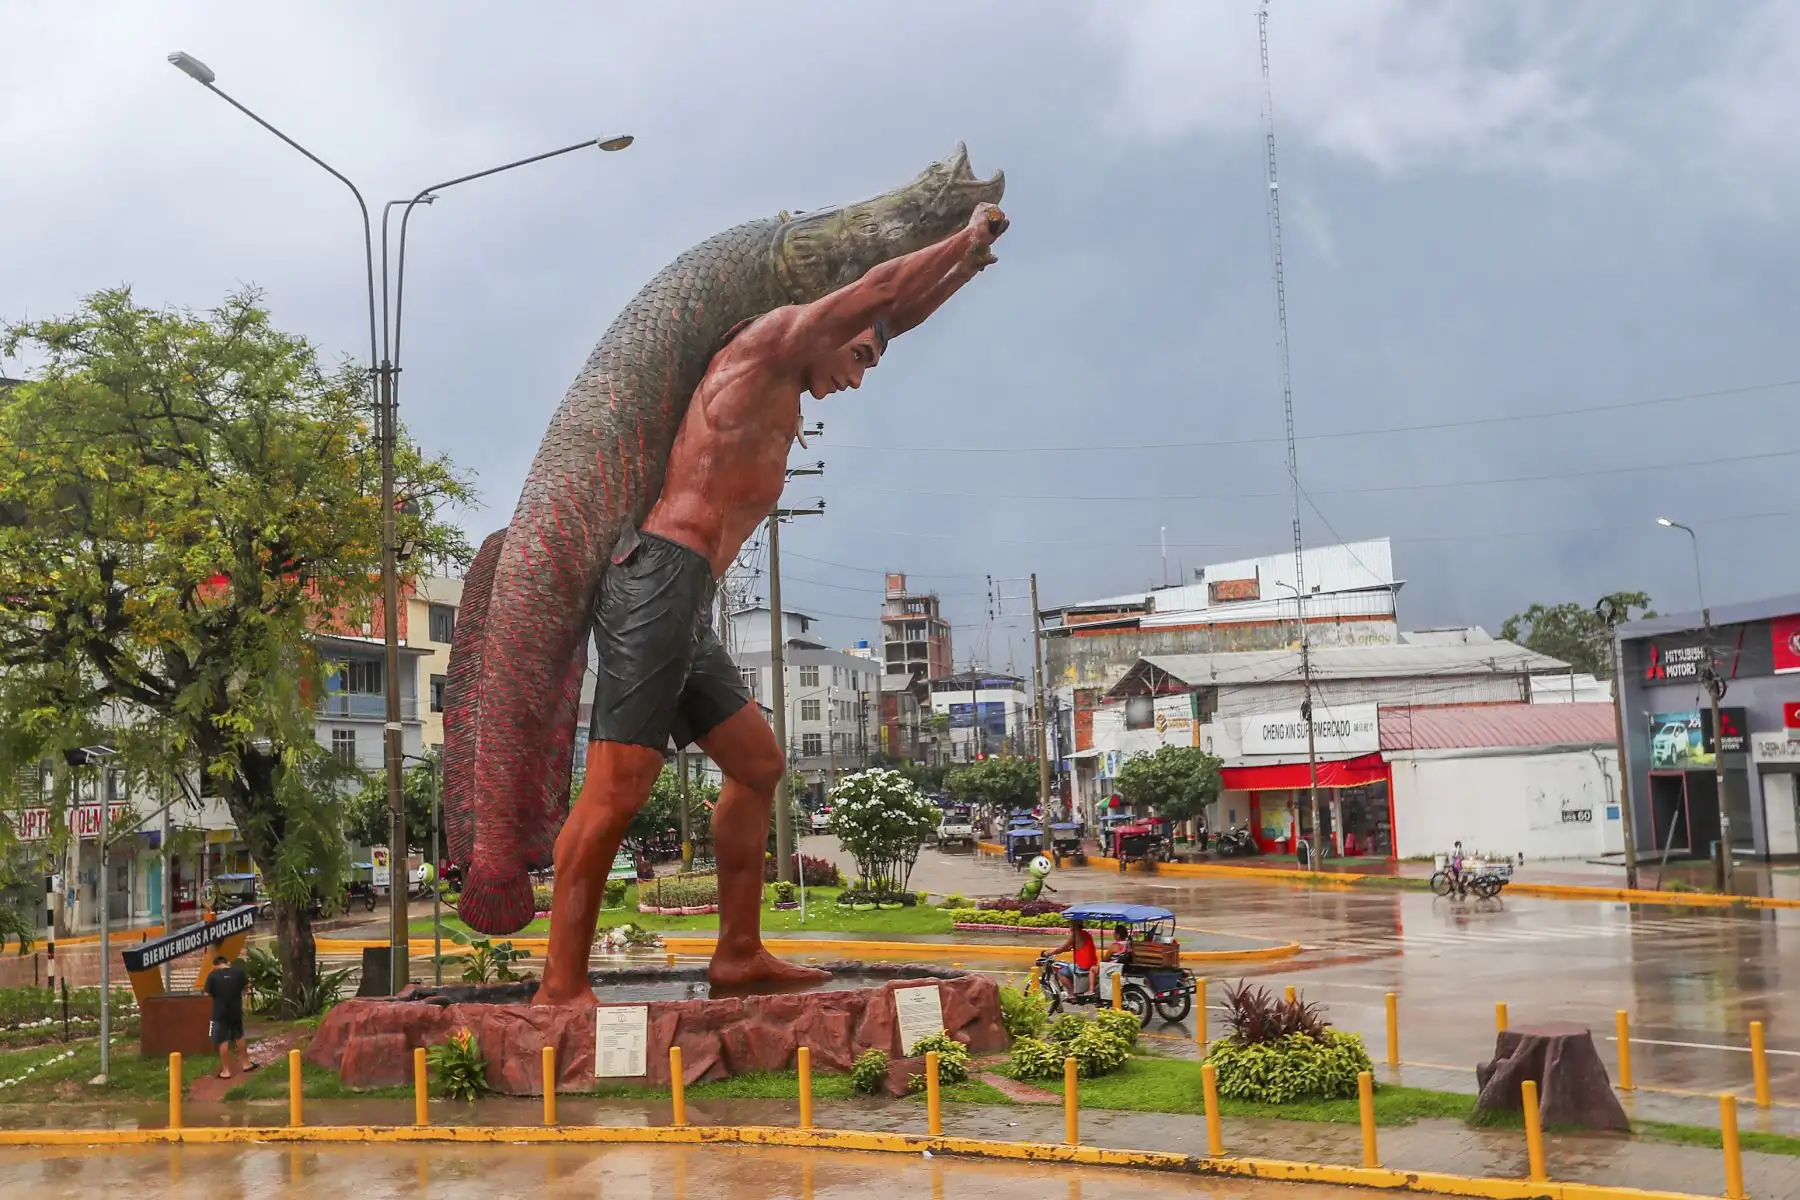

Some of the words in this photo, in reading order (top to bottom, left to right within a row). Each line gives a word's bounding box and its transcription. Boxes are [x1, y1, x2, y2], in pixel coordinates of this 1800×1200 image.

[1666, 662, 1697, 678] MOTORS
[1263, 723, 1285, 740] CHENG
[1285, 722, 1296, 739] XIN
[1296, 720, 1351, 739] SUPRMERCADO
[143, 931, 202, 967] BIENVENIDOS
[203, 930, 210, 943] A
[209, 912, 254, 941] PUCALLPA
